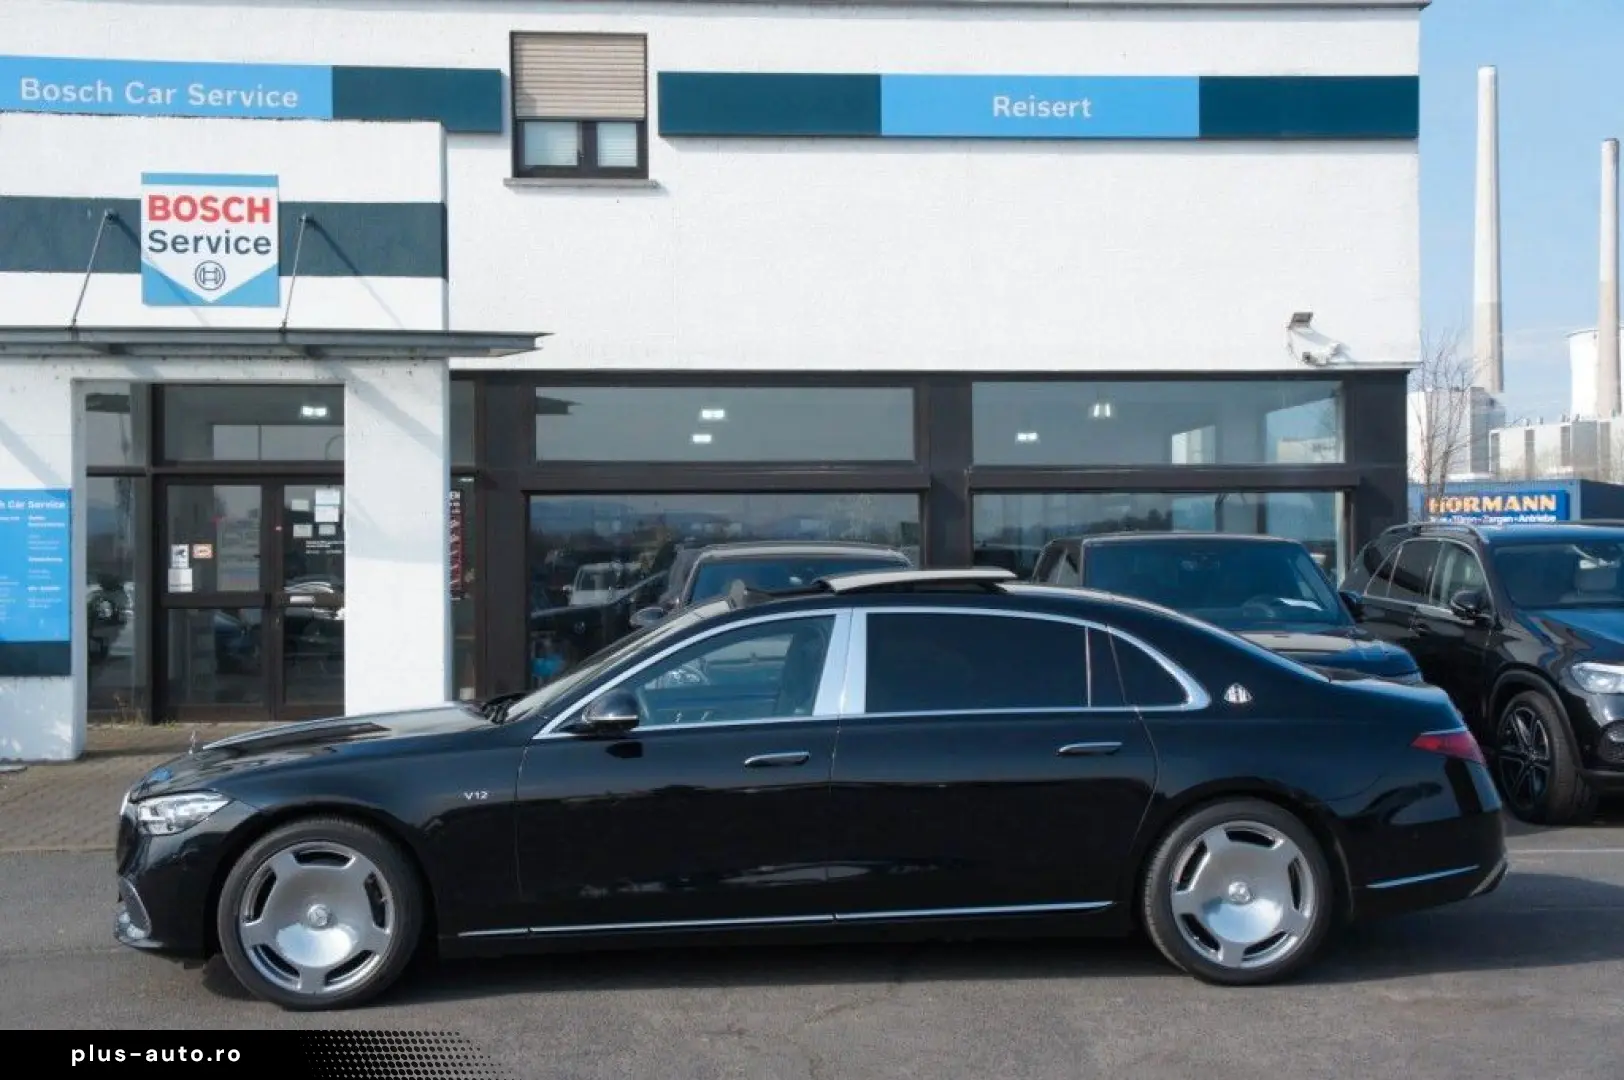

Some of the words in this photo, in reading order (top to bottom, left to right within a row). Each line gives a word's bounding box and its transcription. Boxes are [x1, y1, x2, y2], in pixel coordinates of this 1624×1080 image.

[20, 77, 113, 104] Bosch
[124, 80, 177, 106] Car
[187, 83, 299, 109] Service
[993, 94, 1092, 118] Reisert
[148, 194, 270, 223] BOSCH
[148, 229, 272, 255] Service
[463, 790, 488, 800] V12
